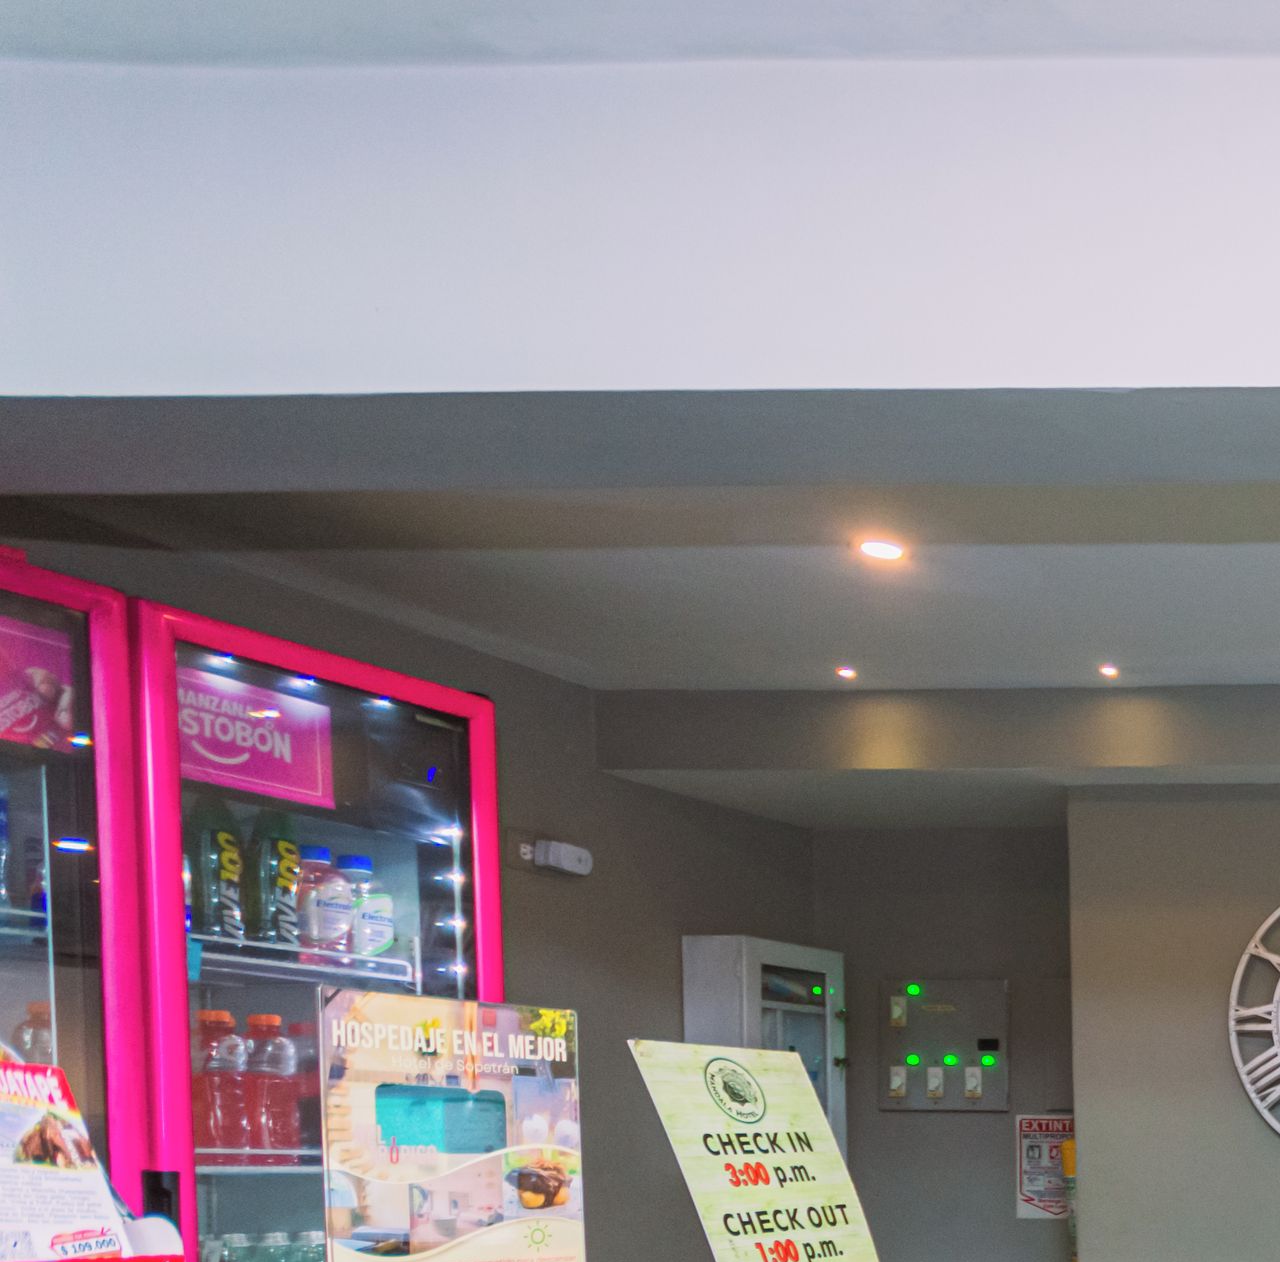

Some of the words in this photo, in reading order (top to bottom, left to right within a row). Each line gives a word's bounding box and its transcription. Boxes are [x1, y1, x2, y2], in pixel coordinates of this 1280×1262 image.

[331, 1019, 447, 1054] HOSPEDAJE
[452, 1030, 479, 1056] EN
[482, 1032, 505, 1058] EL
[508, 1033, 568, 1062] MEJOR
[392, 1056, 432, 1069] Hotel
[435, 1058, 453, 1071] de
[456, 1059, 520, 1075] Sopetrán
[1022, 1119, 1074, 1132] EXTINT
[702, 1132, 786, 1156] CHECK
[789, 1131, 815, 1153] IN
[724, 1162, 771, 1187] 3:00
[773, 1164, 817, 1188] p.m.
[723, 1208, 806, 1236] CHECK
[807, 1204, 851, 1228] OUT
